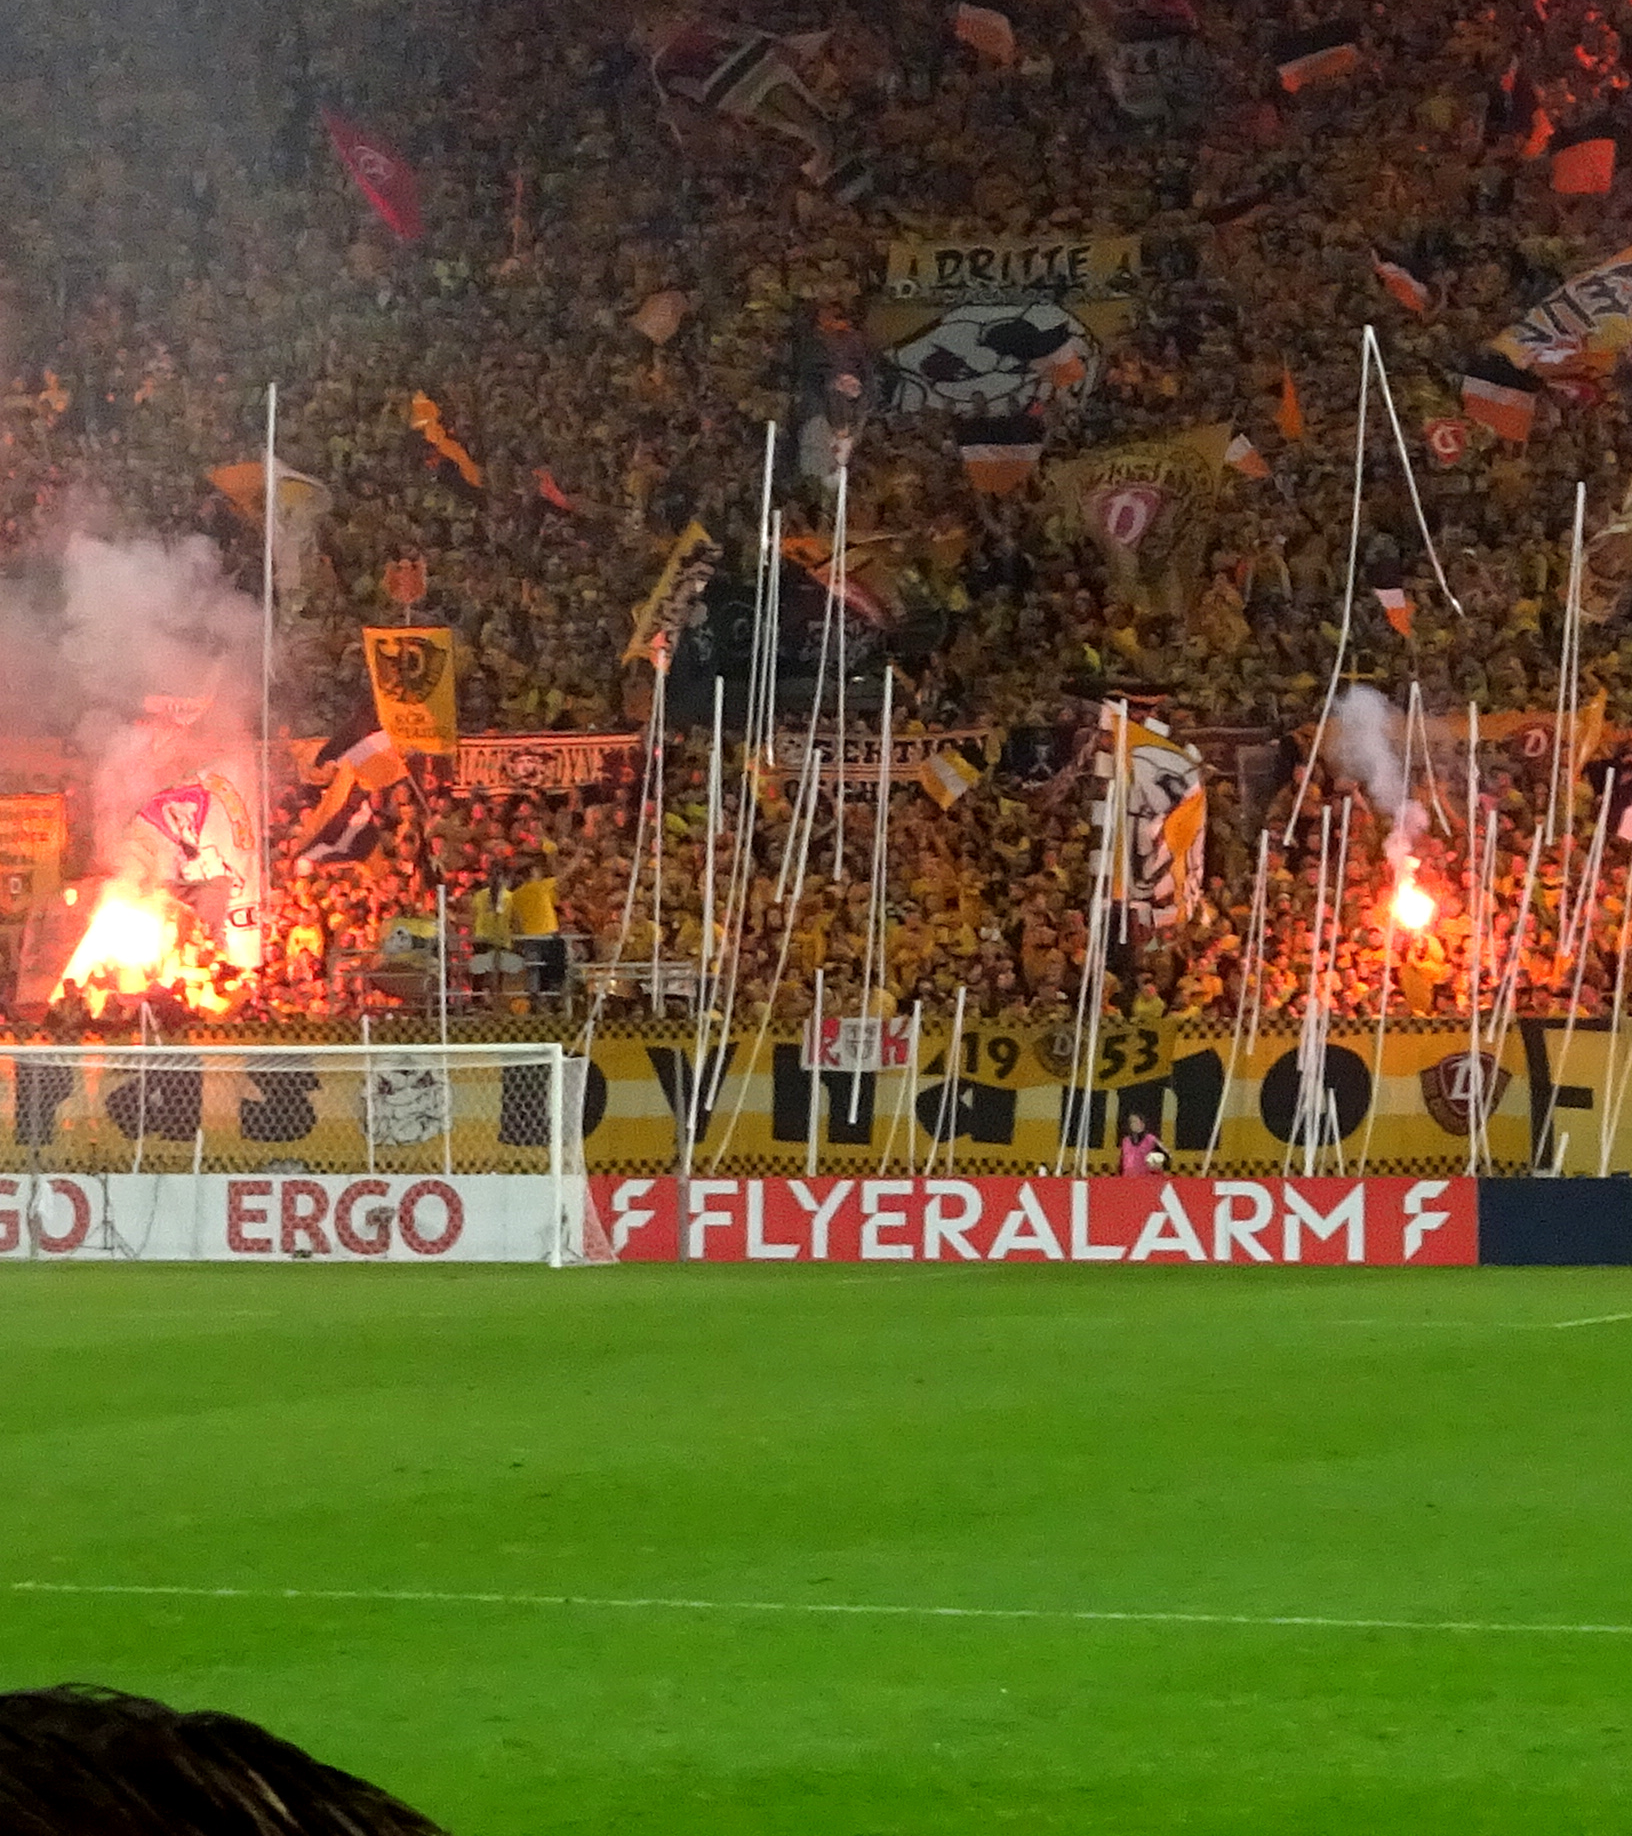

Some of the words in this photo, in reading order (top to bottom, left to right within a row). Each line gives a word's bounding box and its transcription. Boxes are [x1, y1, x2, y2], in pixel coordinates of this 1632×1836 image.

[934, 244, 1090, 284] DRITTE
[225, 1178, 465, 1256] ERGO
[688, 1179, 1365, 1263] FLYERALARM
